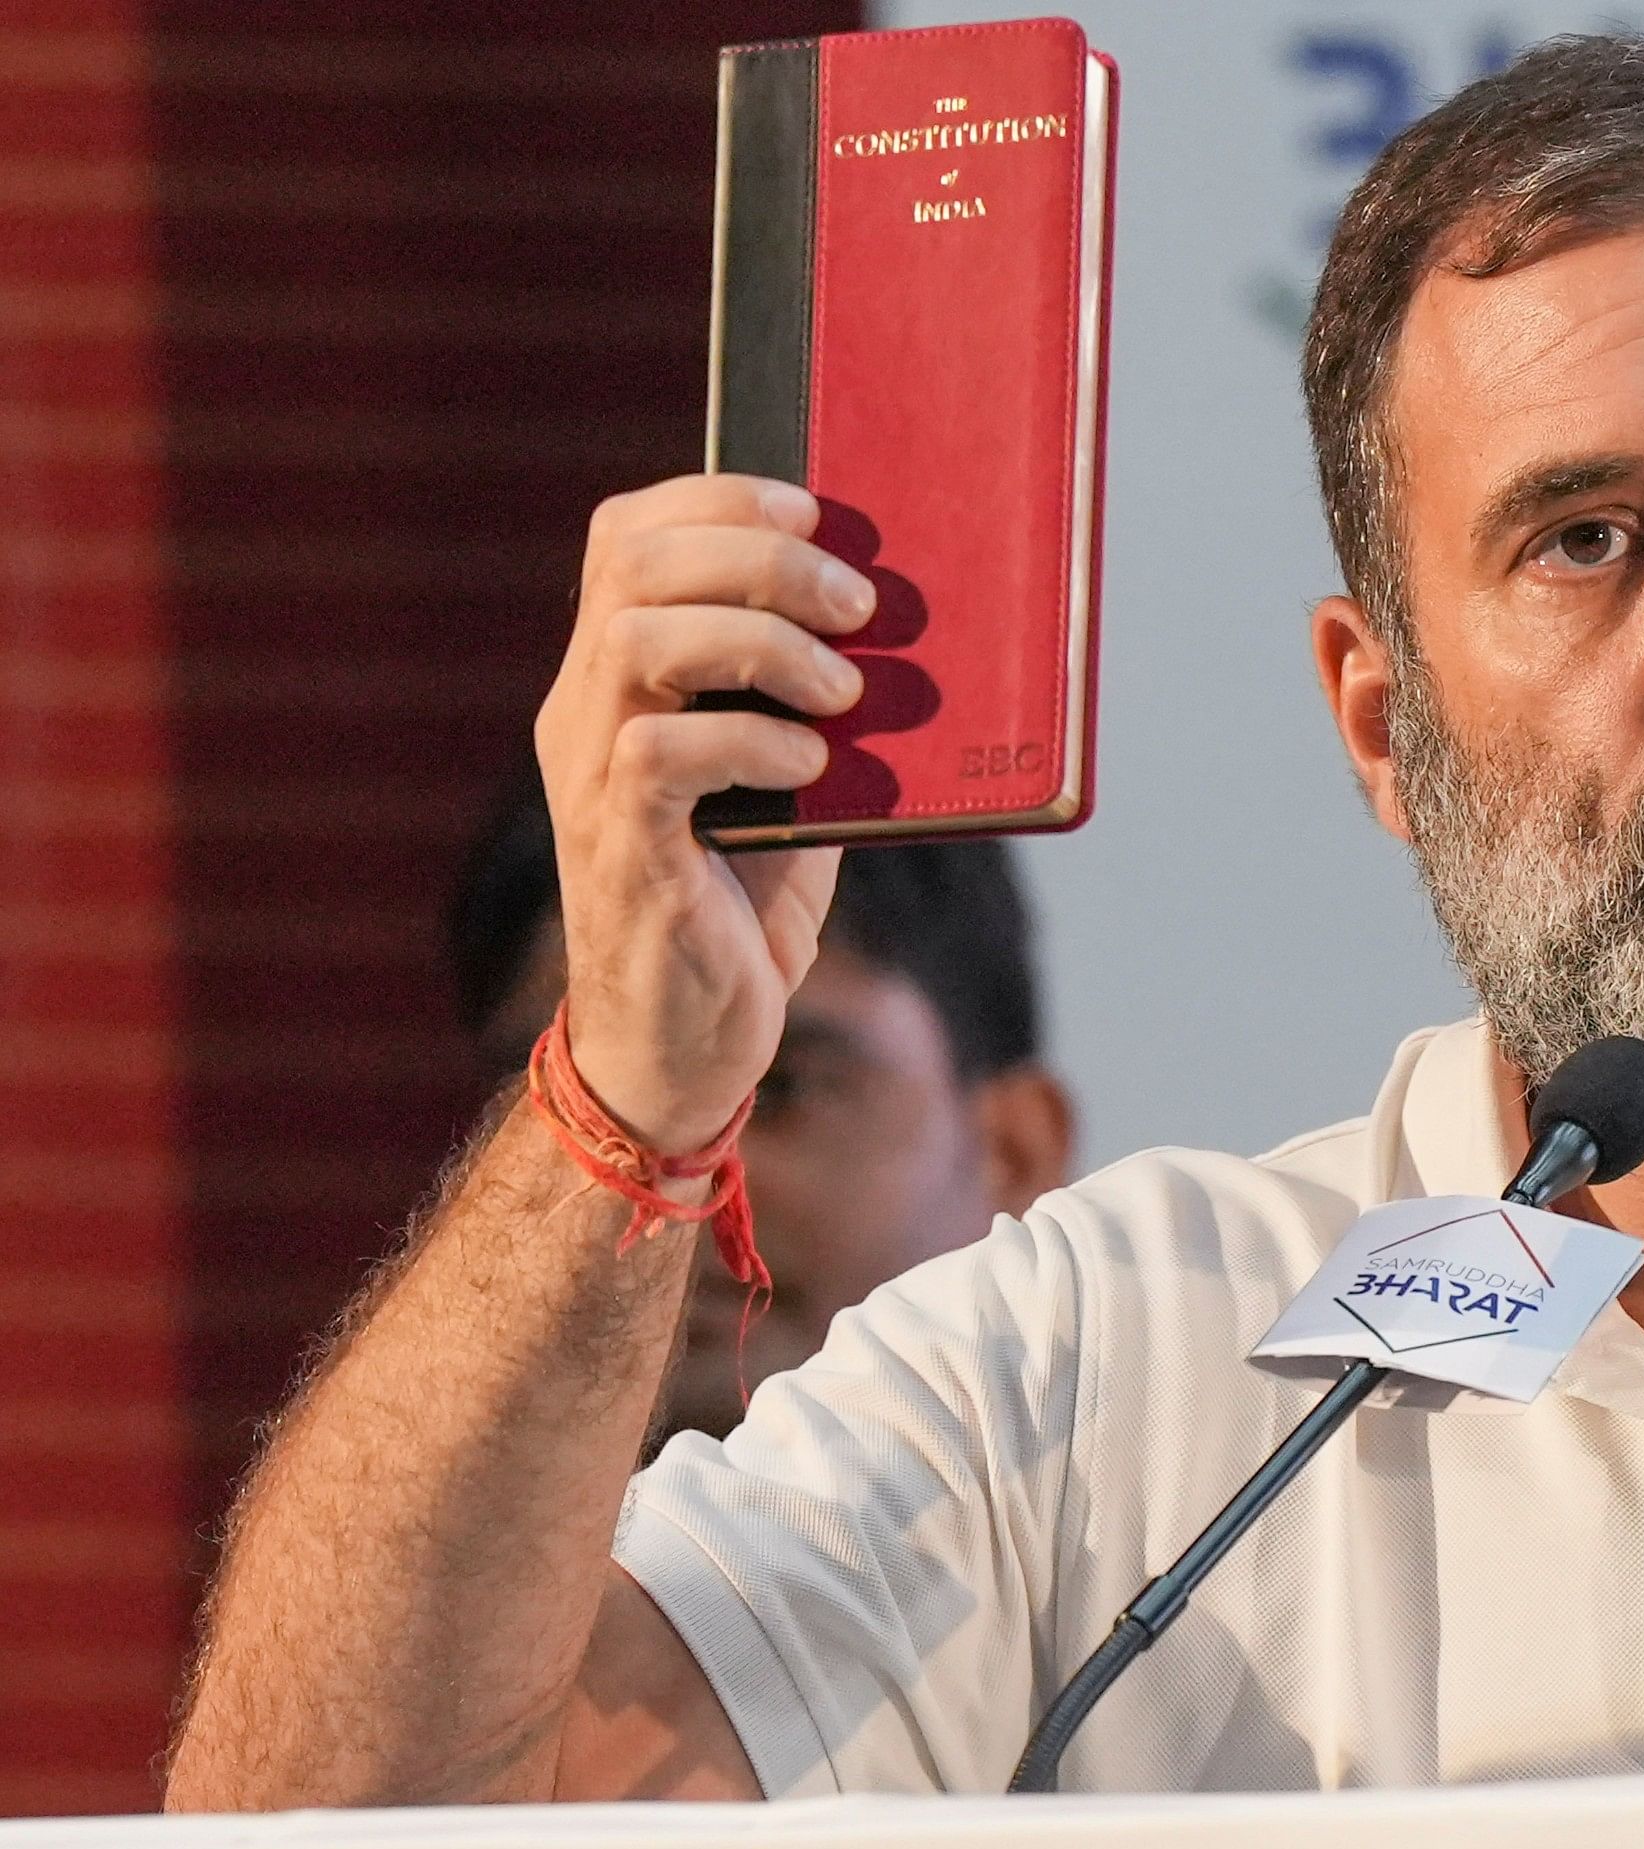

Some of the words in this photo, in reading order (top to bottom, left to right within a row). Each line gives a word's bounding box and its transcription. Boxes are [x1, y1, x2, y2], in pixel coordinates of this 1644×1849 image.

[933, 97, 968, 114] THE
[834, 114, 1067, 157] CONSTITUTION
[940, 169, 959, 188] of
[914, 198, 986, 223] INDIA
[1364, 1257, 1545, 1303] SAMRUDDHA
[1347, 1273, 1539, 1325] BHARAT
